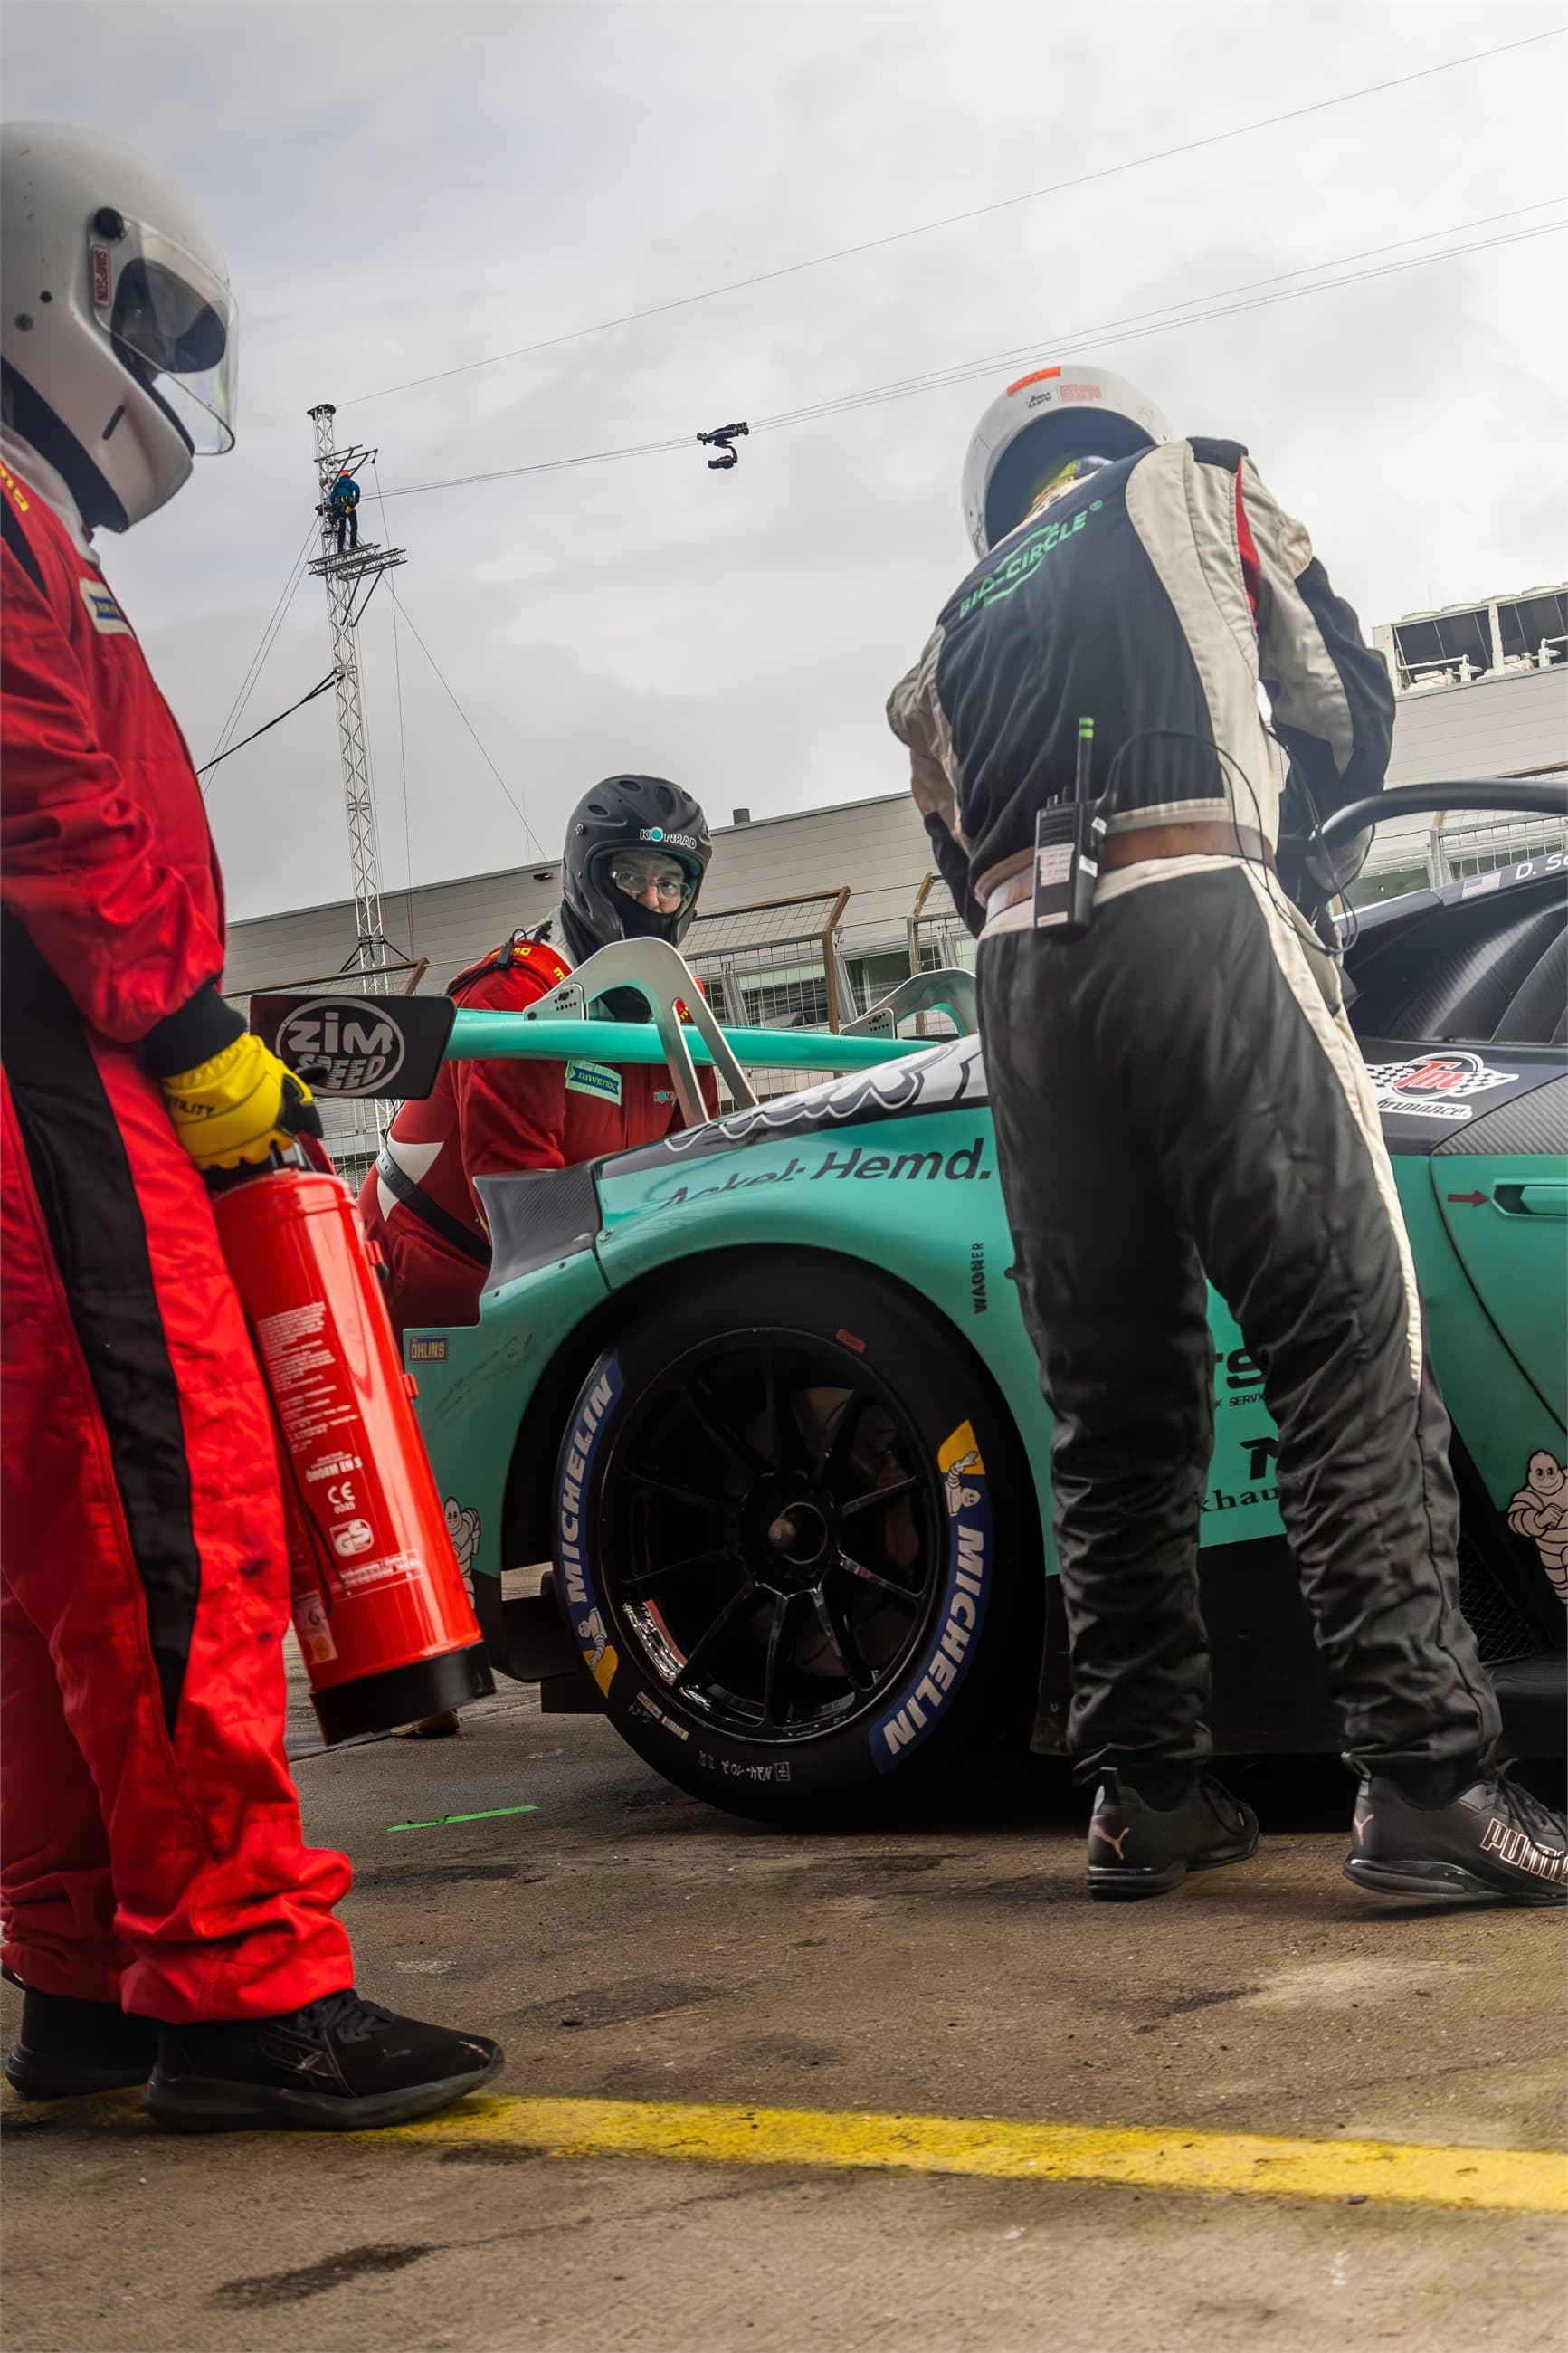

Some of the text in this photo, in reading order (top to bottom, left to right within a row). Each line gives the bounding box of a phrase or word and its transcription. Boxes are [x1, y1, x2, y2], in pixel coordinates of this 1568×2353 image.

[639, 826, 697, 849] KONRAD
[1515, 862, 1537, 881] D.
[810, 1138, 992, 1181] Hemd.
[411, 1338, 445, 1359] ÖHLINS
[561, 1373, 613, 1604] MICHELIN
[882, 1524, 984, 1755] MICHELIN
